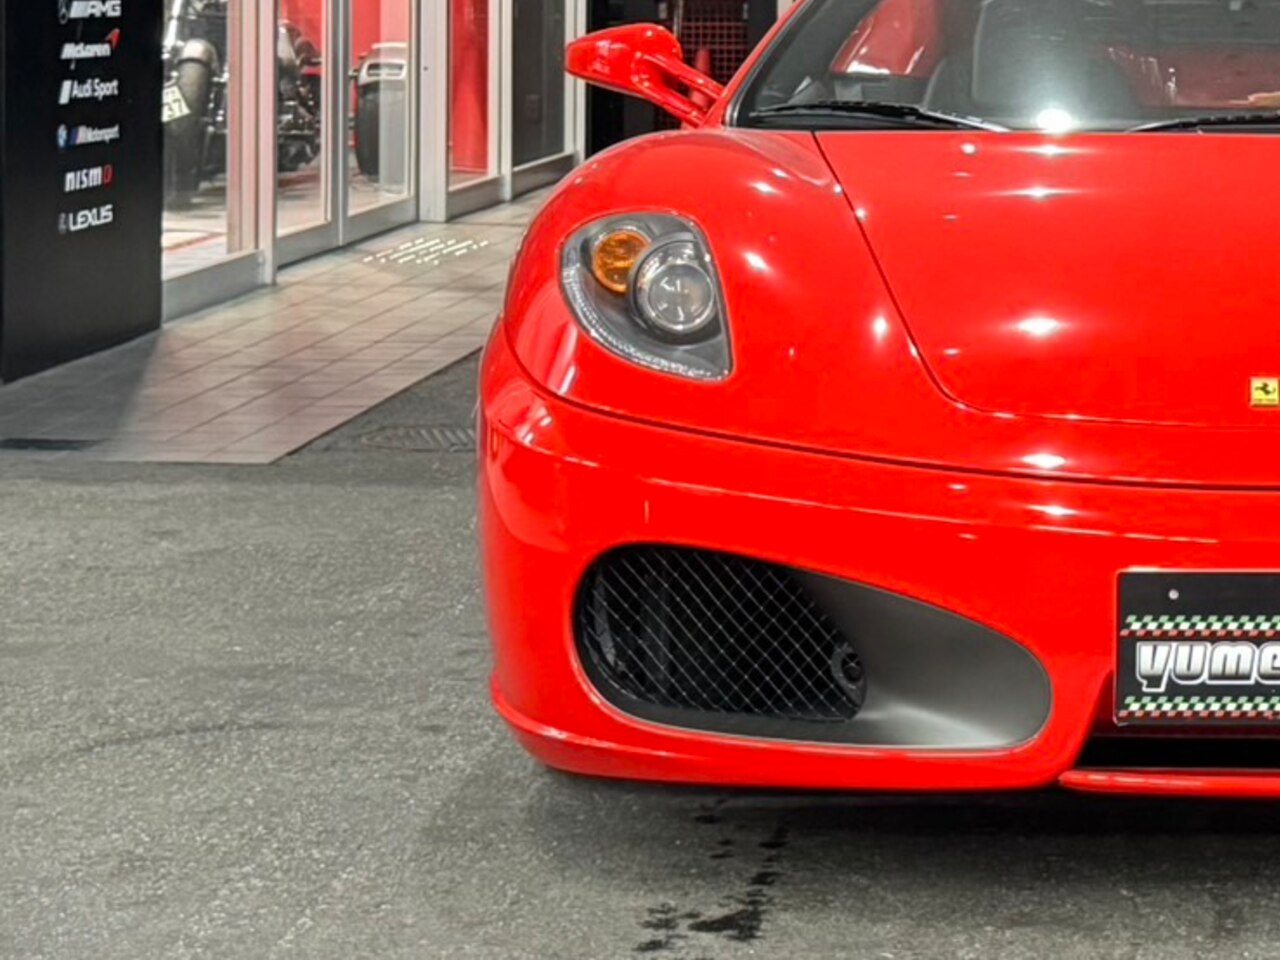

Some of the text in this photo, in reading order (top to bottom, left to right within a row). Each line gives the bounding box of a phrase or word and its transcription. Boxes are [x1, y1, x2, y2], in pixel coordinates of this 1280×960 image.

[71, 78, 119, 101] Audi Sport
[68, 204, 113, 232] LEXUS
